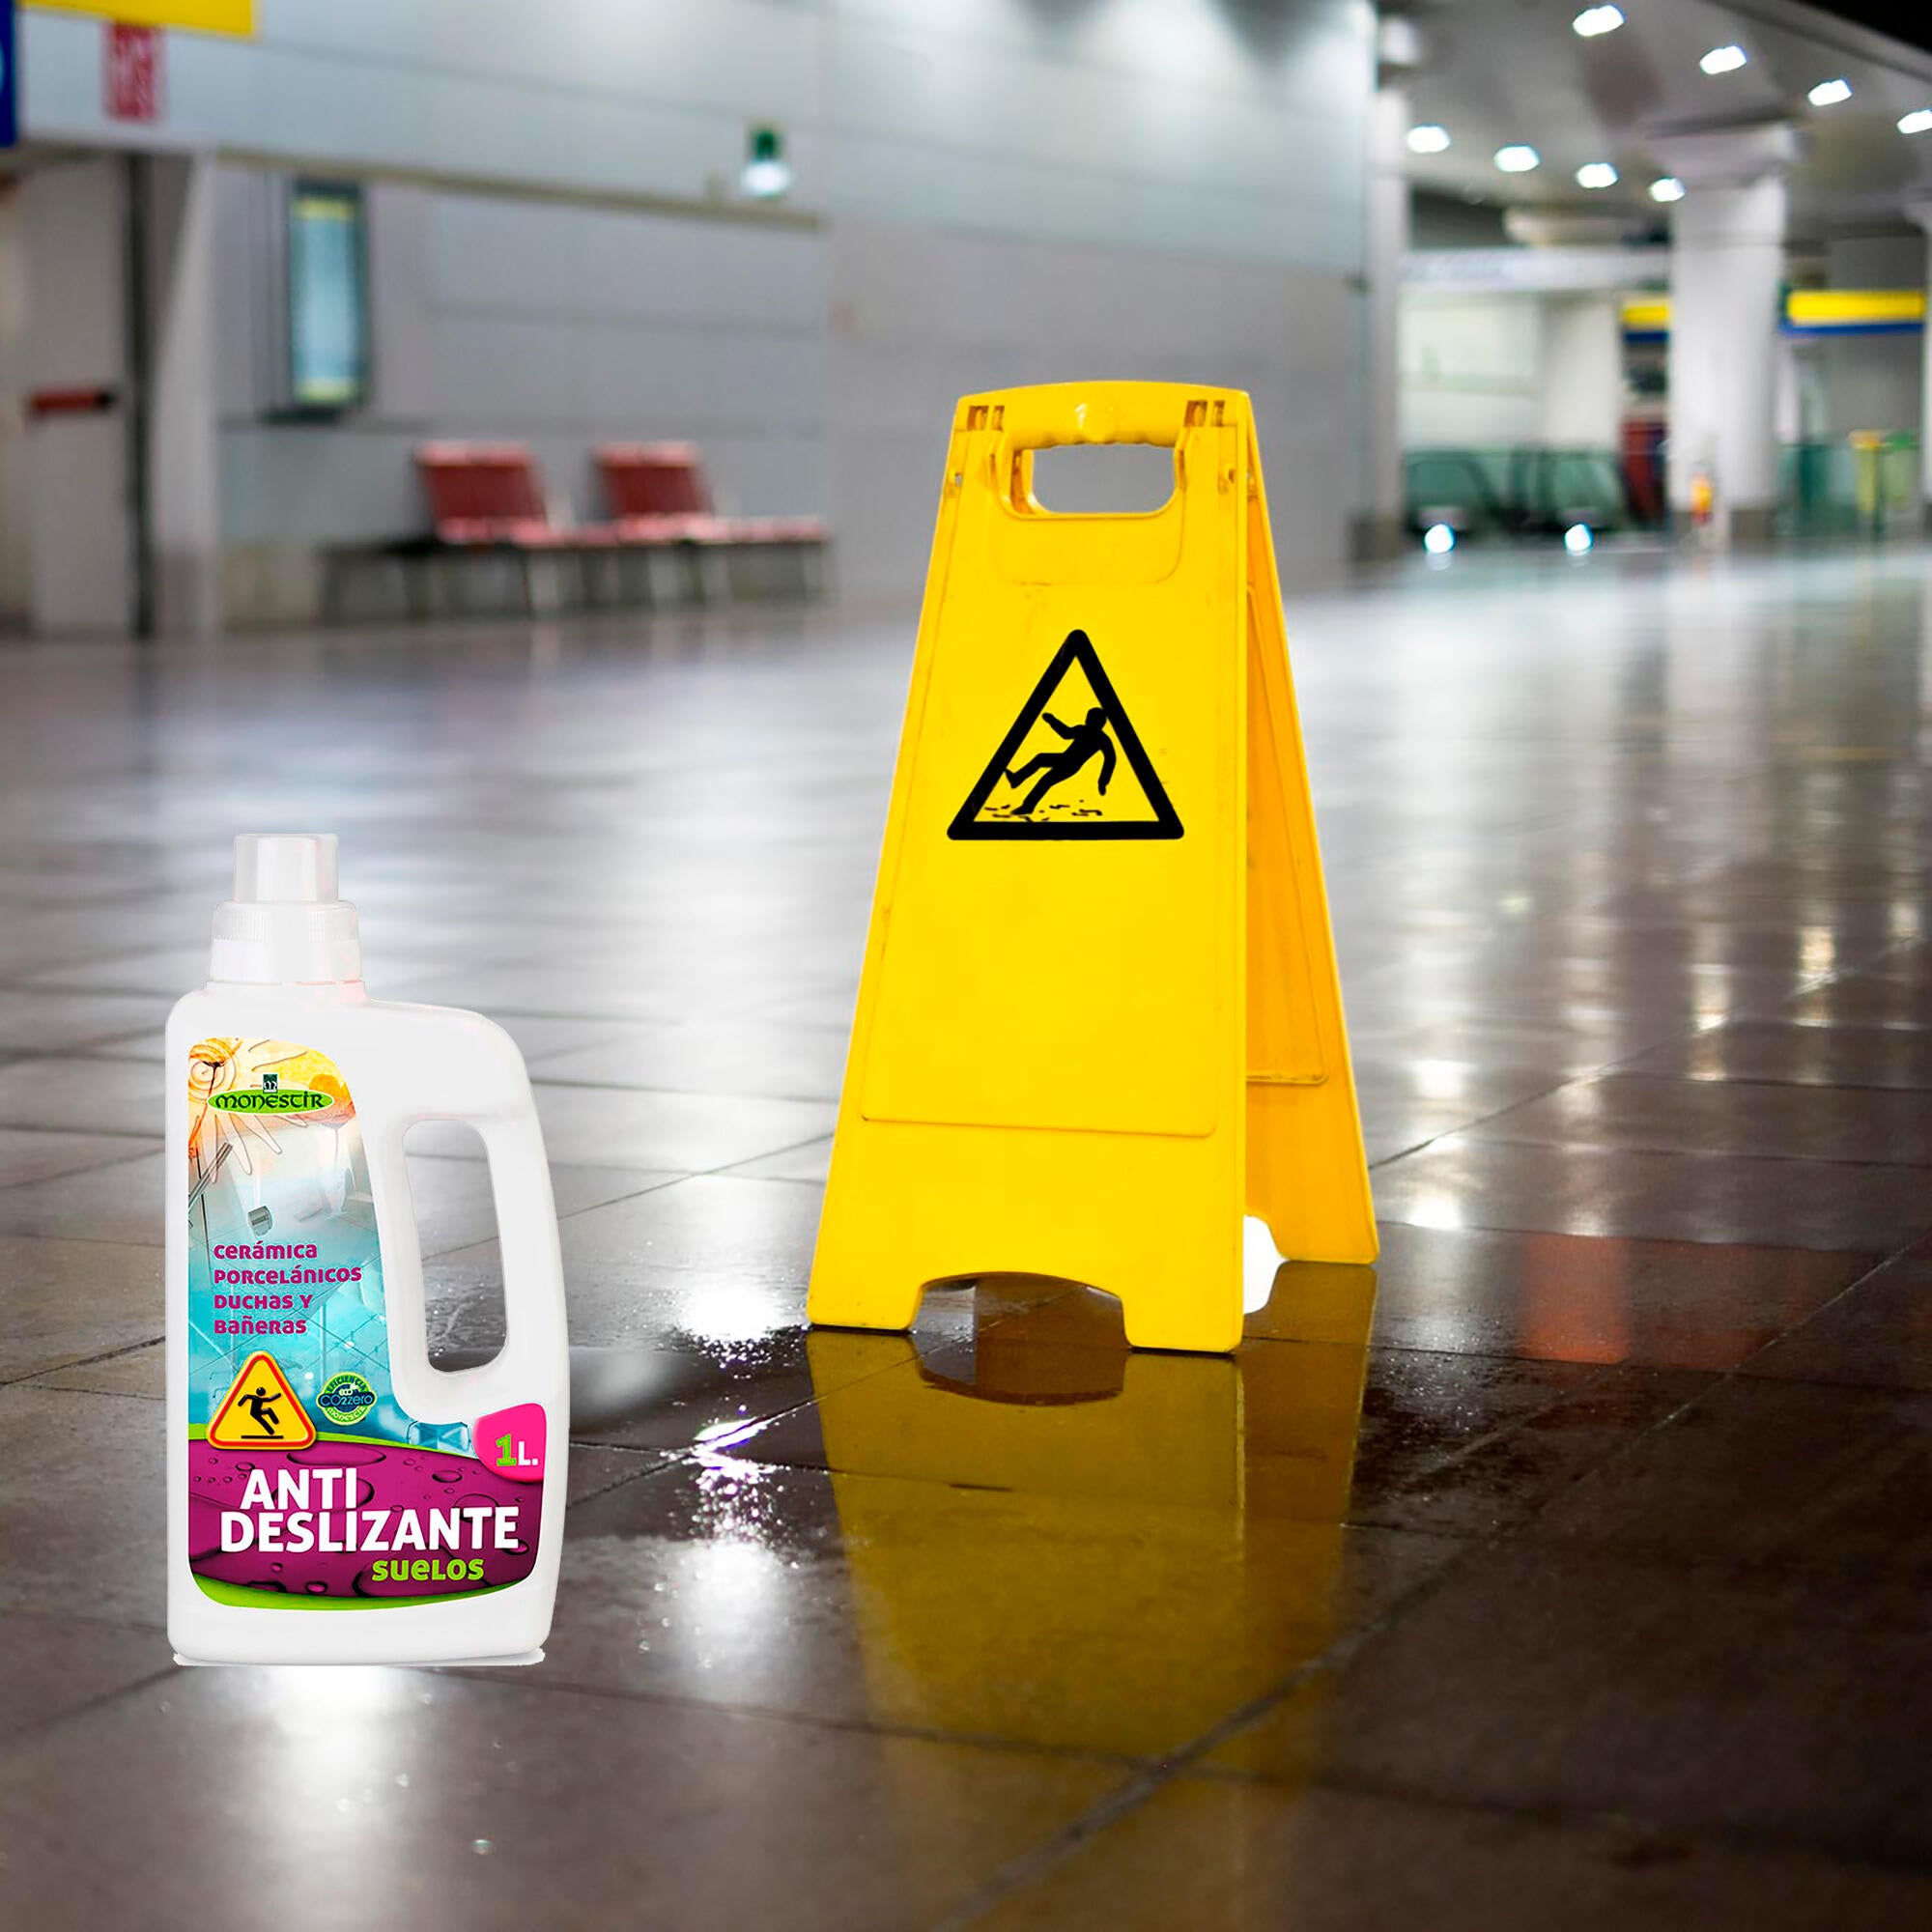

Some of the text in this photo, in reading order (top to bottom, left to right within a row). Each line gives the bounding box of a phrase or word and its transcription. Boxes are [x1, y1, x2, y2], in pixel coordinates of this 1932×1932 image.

[301, 1294, 313, 1309] Y
[240, 1468, 357, 1511] ANTI
[220, 1506, 520, 1553] DESLIZANTE
